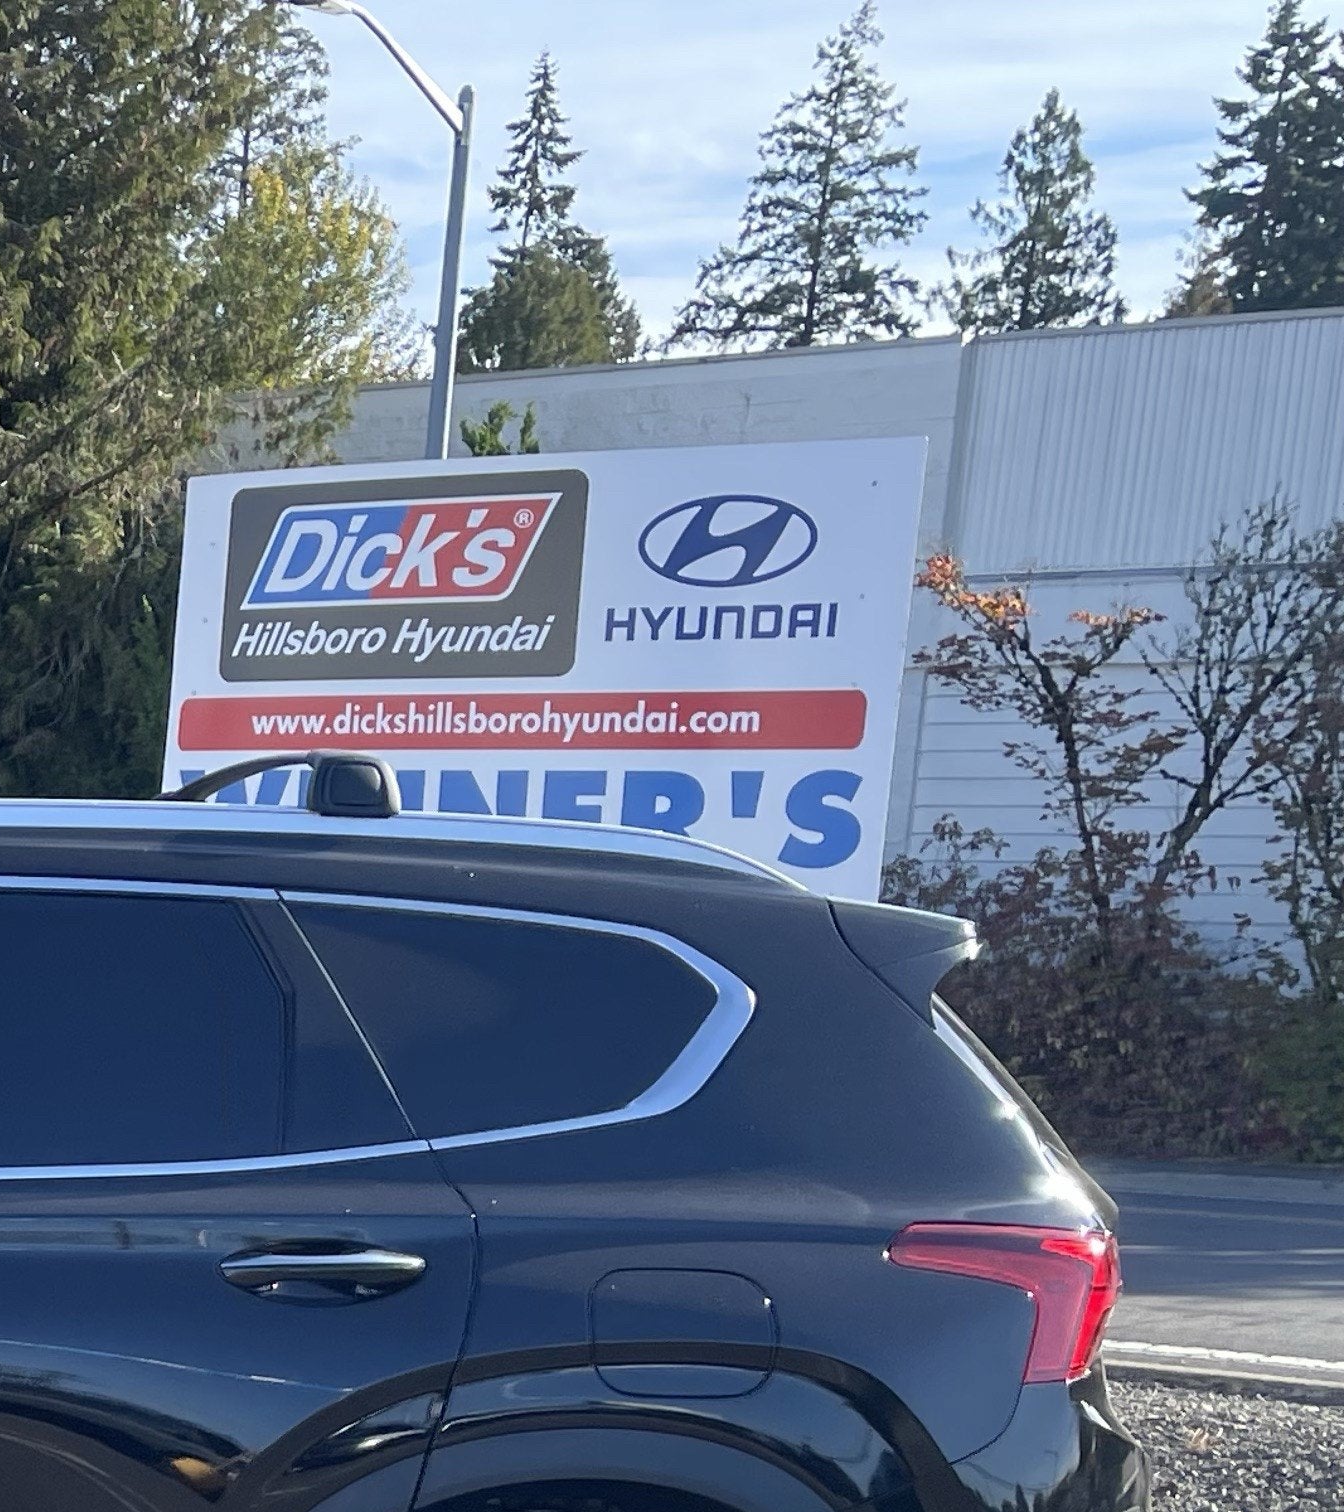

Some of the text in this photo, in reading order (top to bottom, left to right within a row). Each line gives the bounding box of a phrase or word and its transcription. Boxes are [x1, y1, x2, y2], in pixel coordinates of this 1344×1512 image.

[264, 508, 517, 594] Dick's
[231, 614, 557, 663] Hillsboro Hyundai
[604, 603, 838, 642] HYUNDAI
[250, 700, 761, 744] www.dickshillsborohyundai.com
[179, 768, 864, 869] WNER'S
